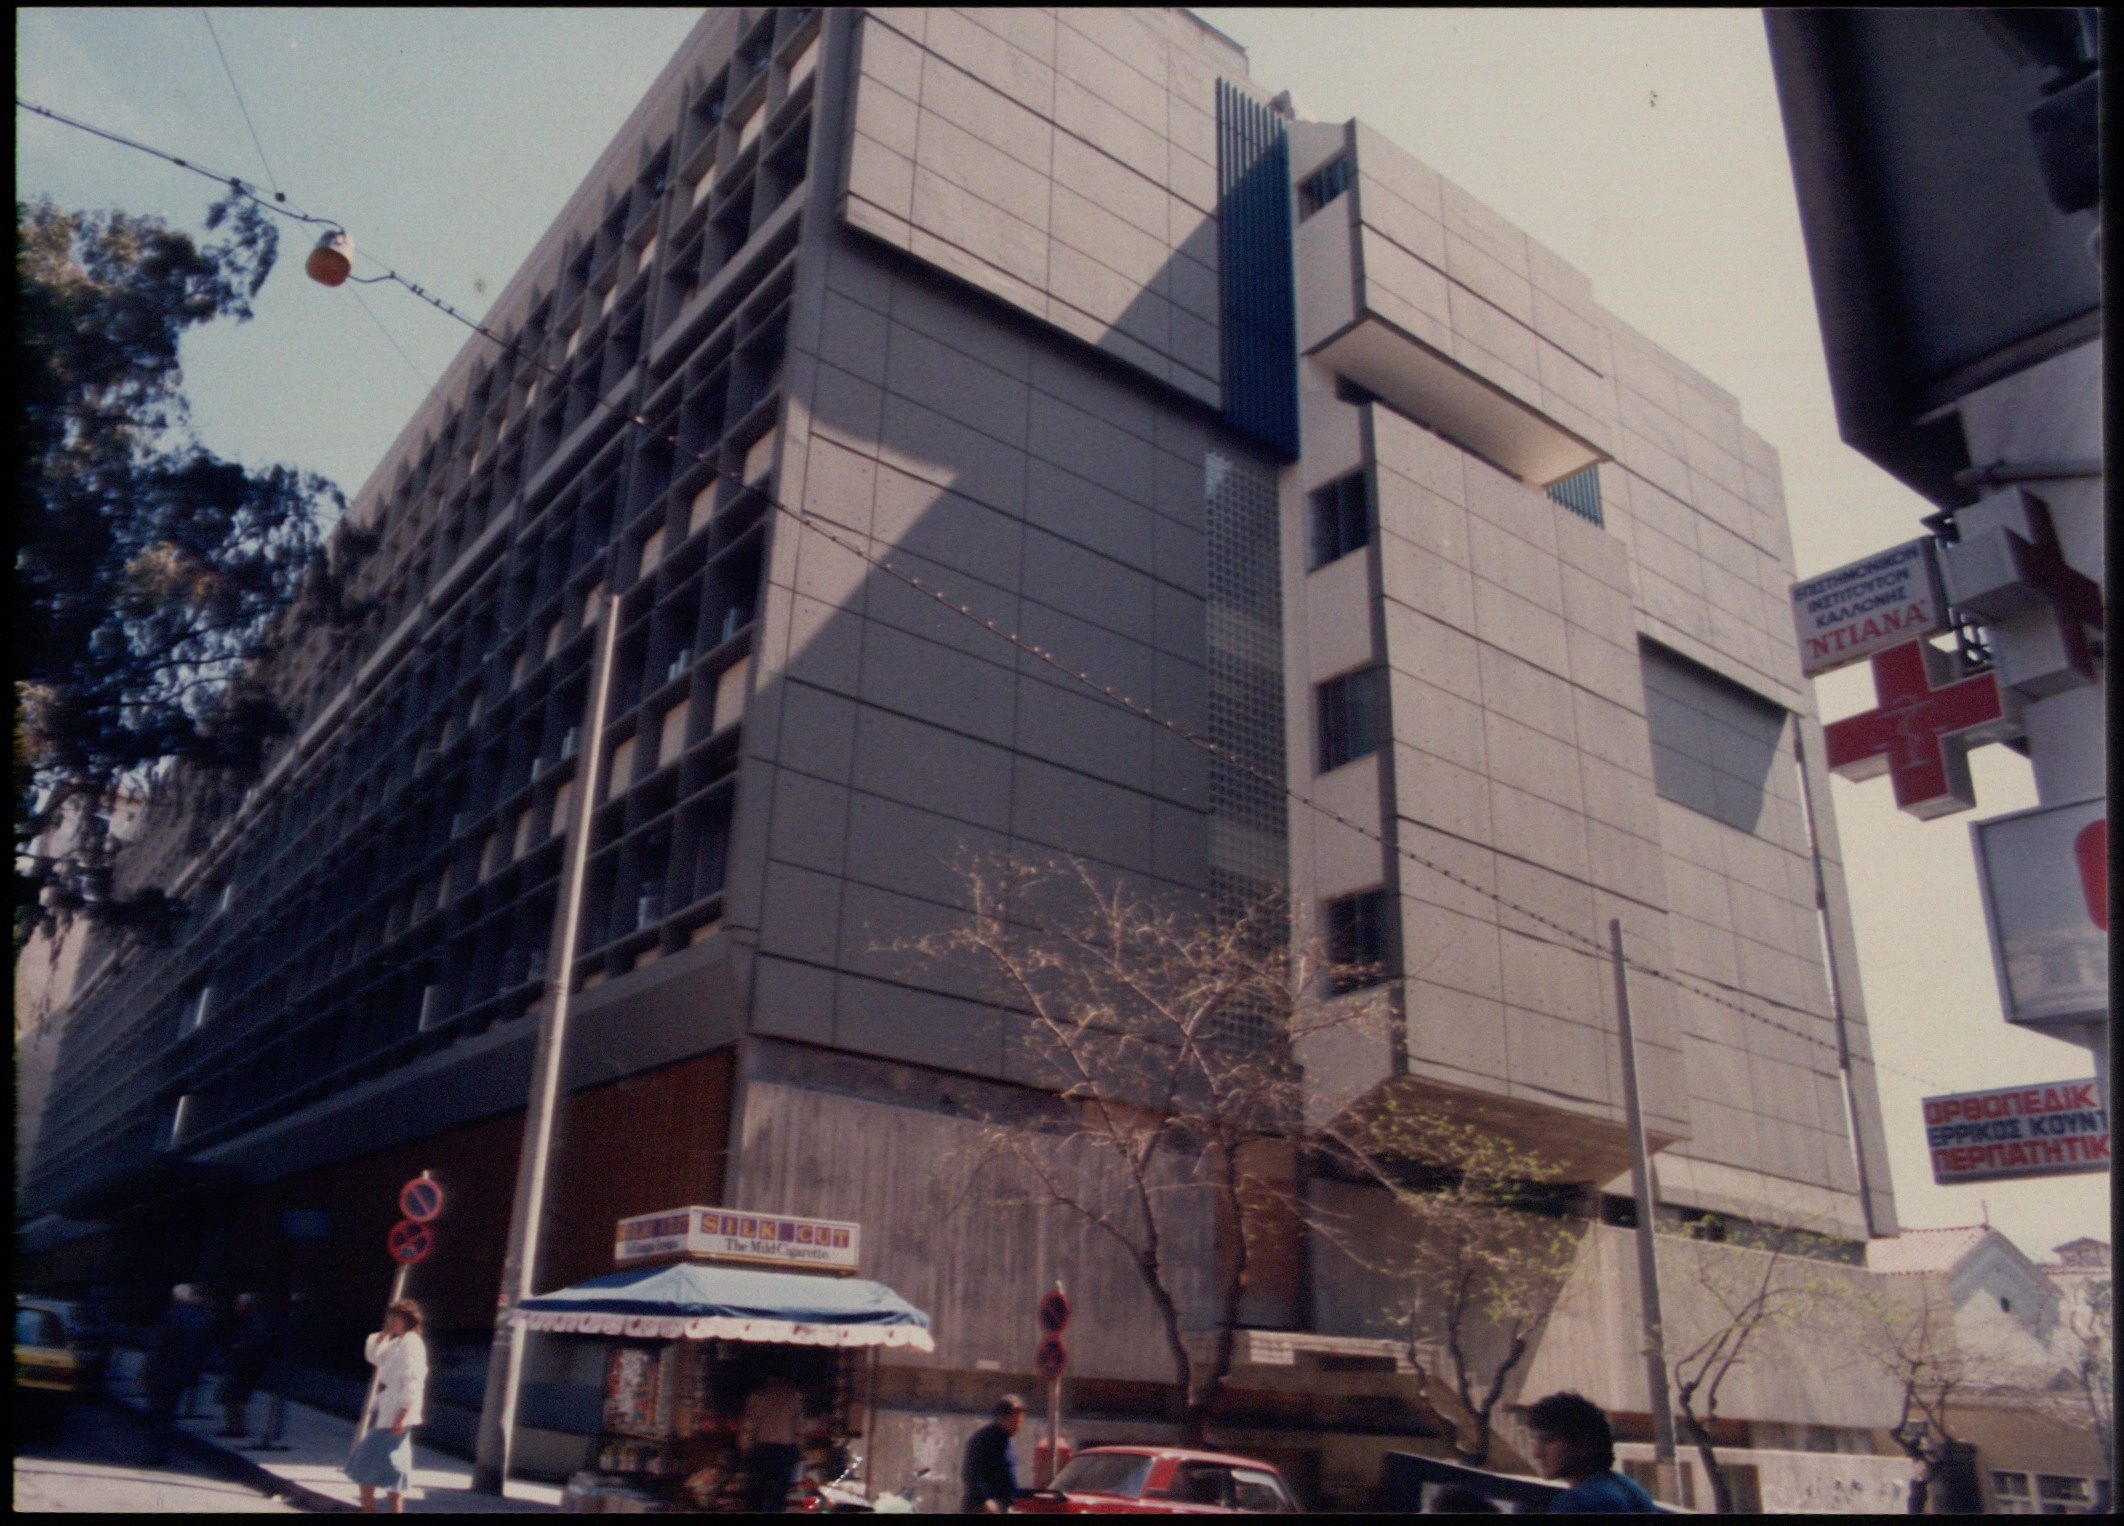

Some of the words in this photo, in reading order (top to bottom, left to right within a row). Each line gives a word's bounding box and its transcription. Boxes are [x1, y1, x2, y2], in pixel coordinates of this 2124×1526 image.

[1816, 586, 1907, 628] ΚΑΛΛΟΝΗΣ
[1927, 1118, 2021, 1147] ΕΡΡΙΚΟΣ
[702, 1213, 777, 1240] SILK
[797, 1225, 849, 1248] CUT
[726, 1238, 749, 1251] The
[751, 1241, 775, 1255] Mild
